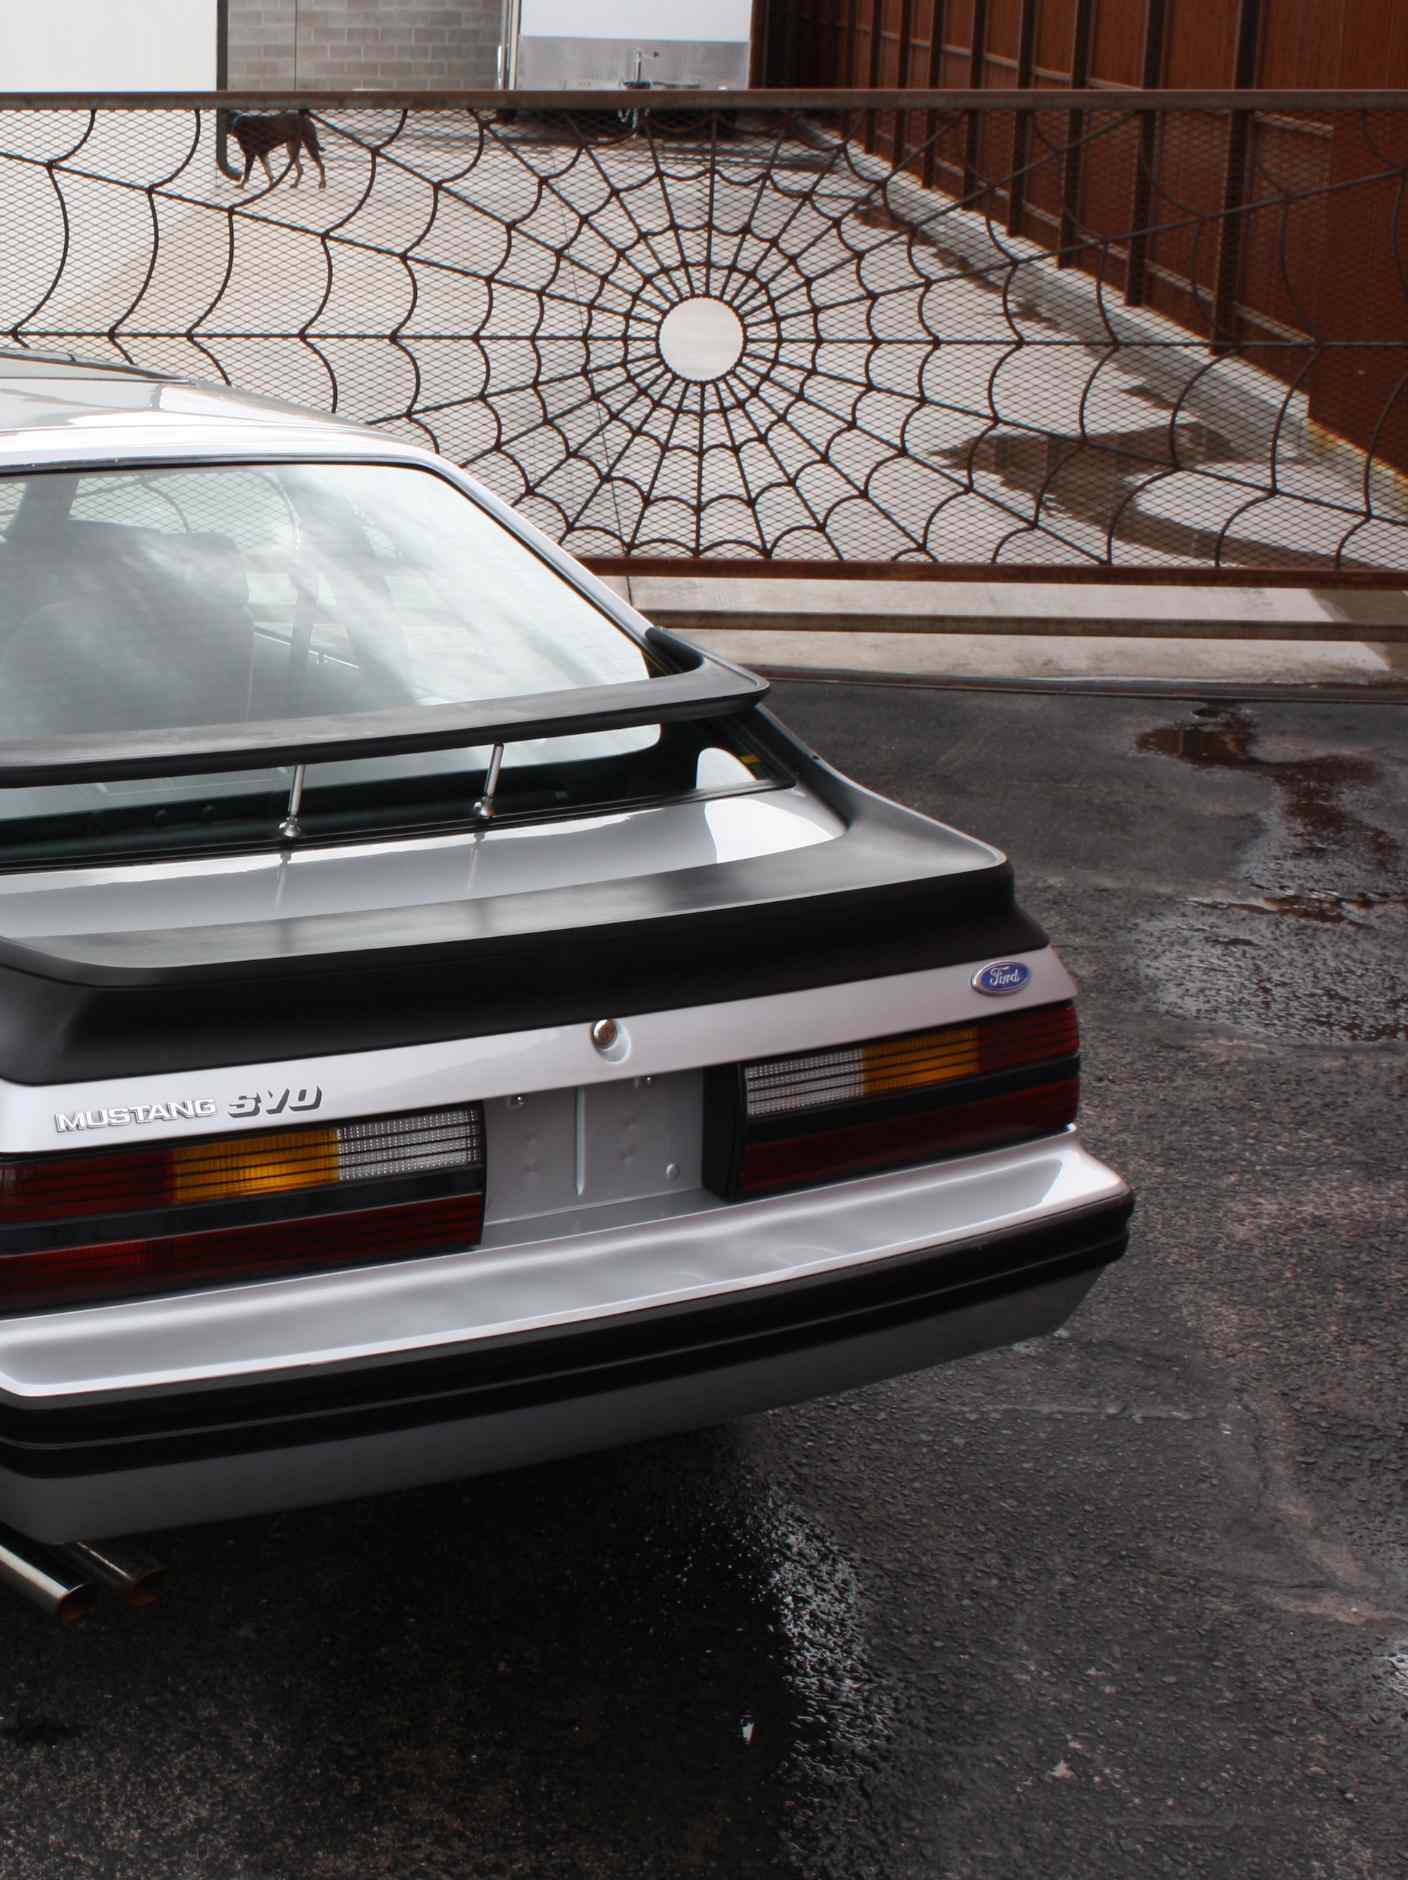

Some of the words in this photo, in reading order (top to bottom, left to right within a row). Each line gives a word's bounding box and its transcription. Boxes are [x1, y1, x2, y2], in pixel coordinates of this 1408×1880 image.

[990, 966, 1021, 986] Ford
[55, 1097, 217, 1134] MUSTANG
[228, 1084, 323, 1118] SVO
